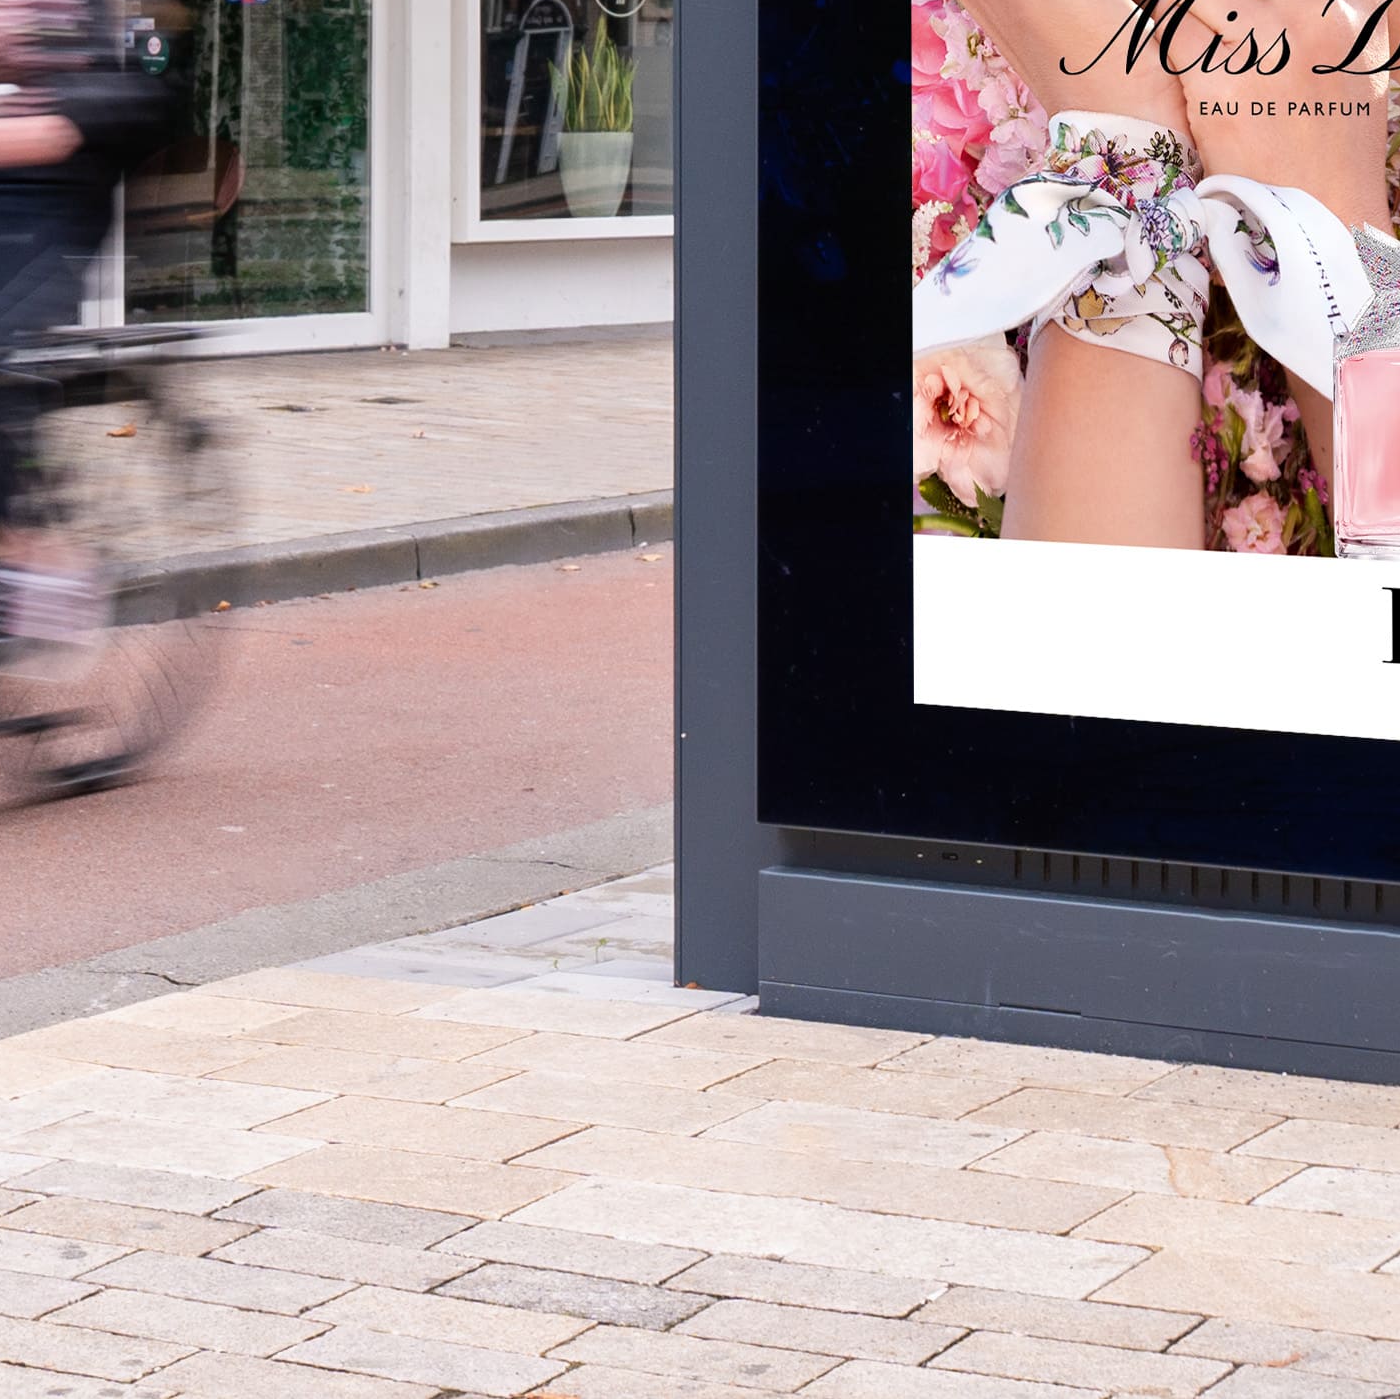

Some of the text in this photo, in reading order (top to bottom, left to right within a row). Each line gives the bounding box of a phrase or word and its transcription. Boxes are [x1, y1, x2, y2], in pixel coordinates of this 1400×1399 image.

[1200, 101, 1370, 116] EAU DE PARFUM
